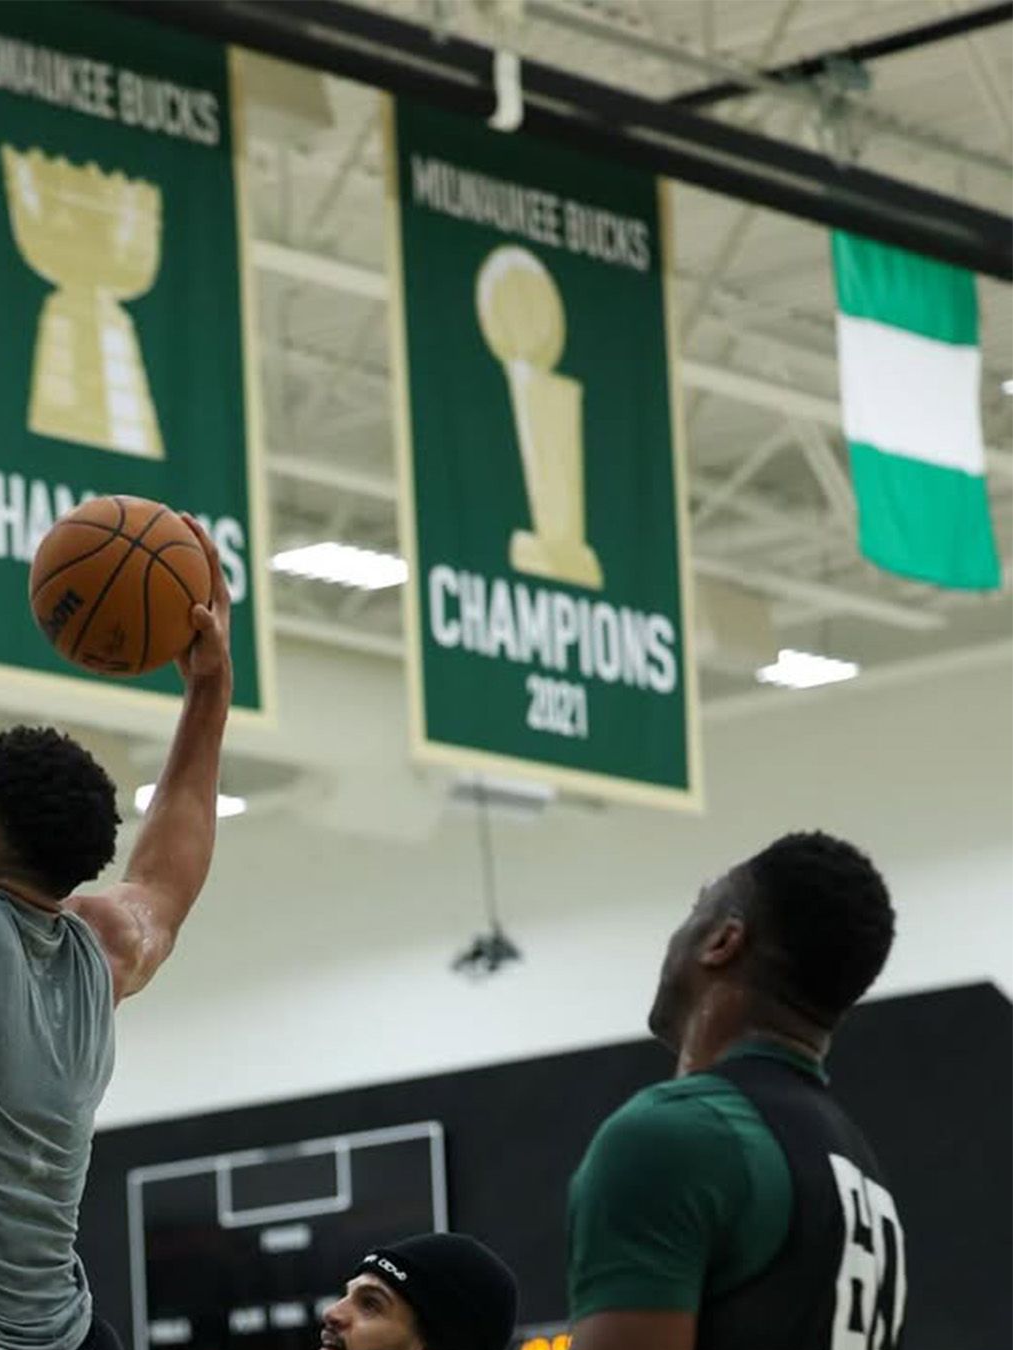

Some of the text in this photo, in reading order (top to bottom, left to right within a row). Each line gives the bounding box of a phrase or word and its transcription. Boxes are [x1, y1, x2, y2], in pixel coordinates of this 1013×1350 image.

[117, 69, 220, 146] BUCKS
[410, 152, 651, 272] MILWAUKEE BUCKS
[428, 564, 677, 694] CHAMPIONS
[525, 673, 588, 740] 2021
